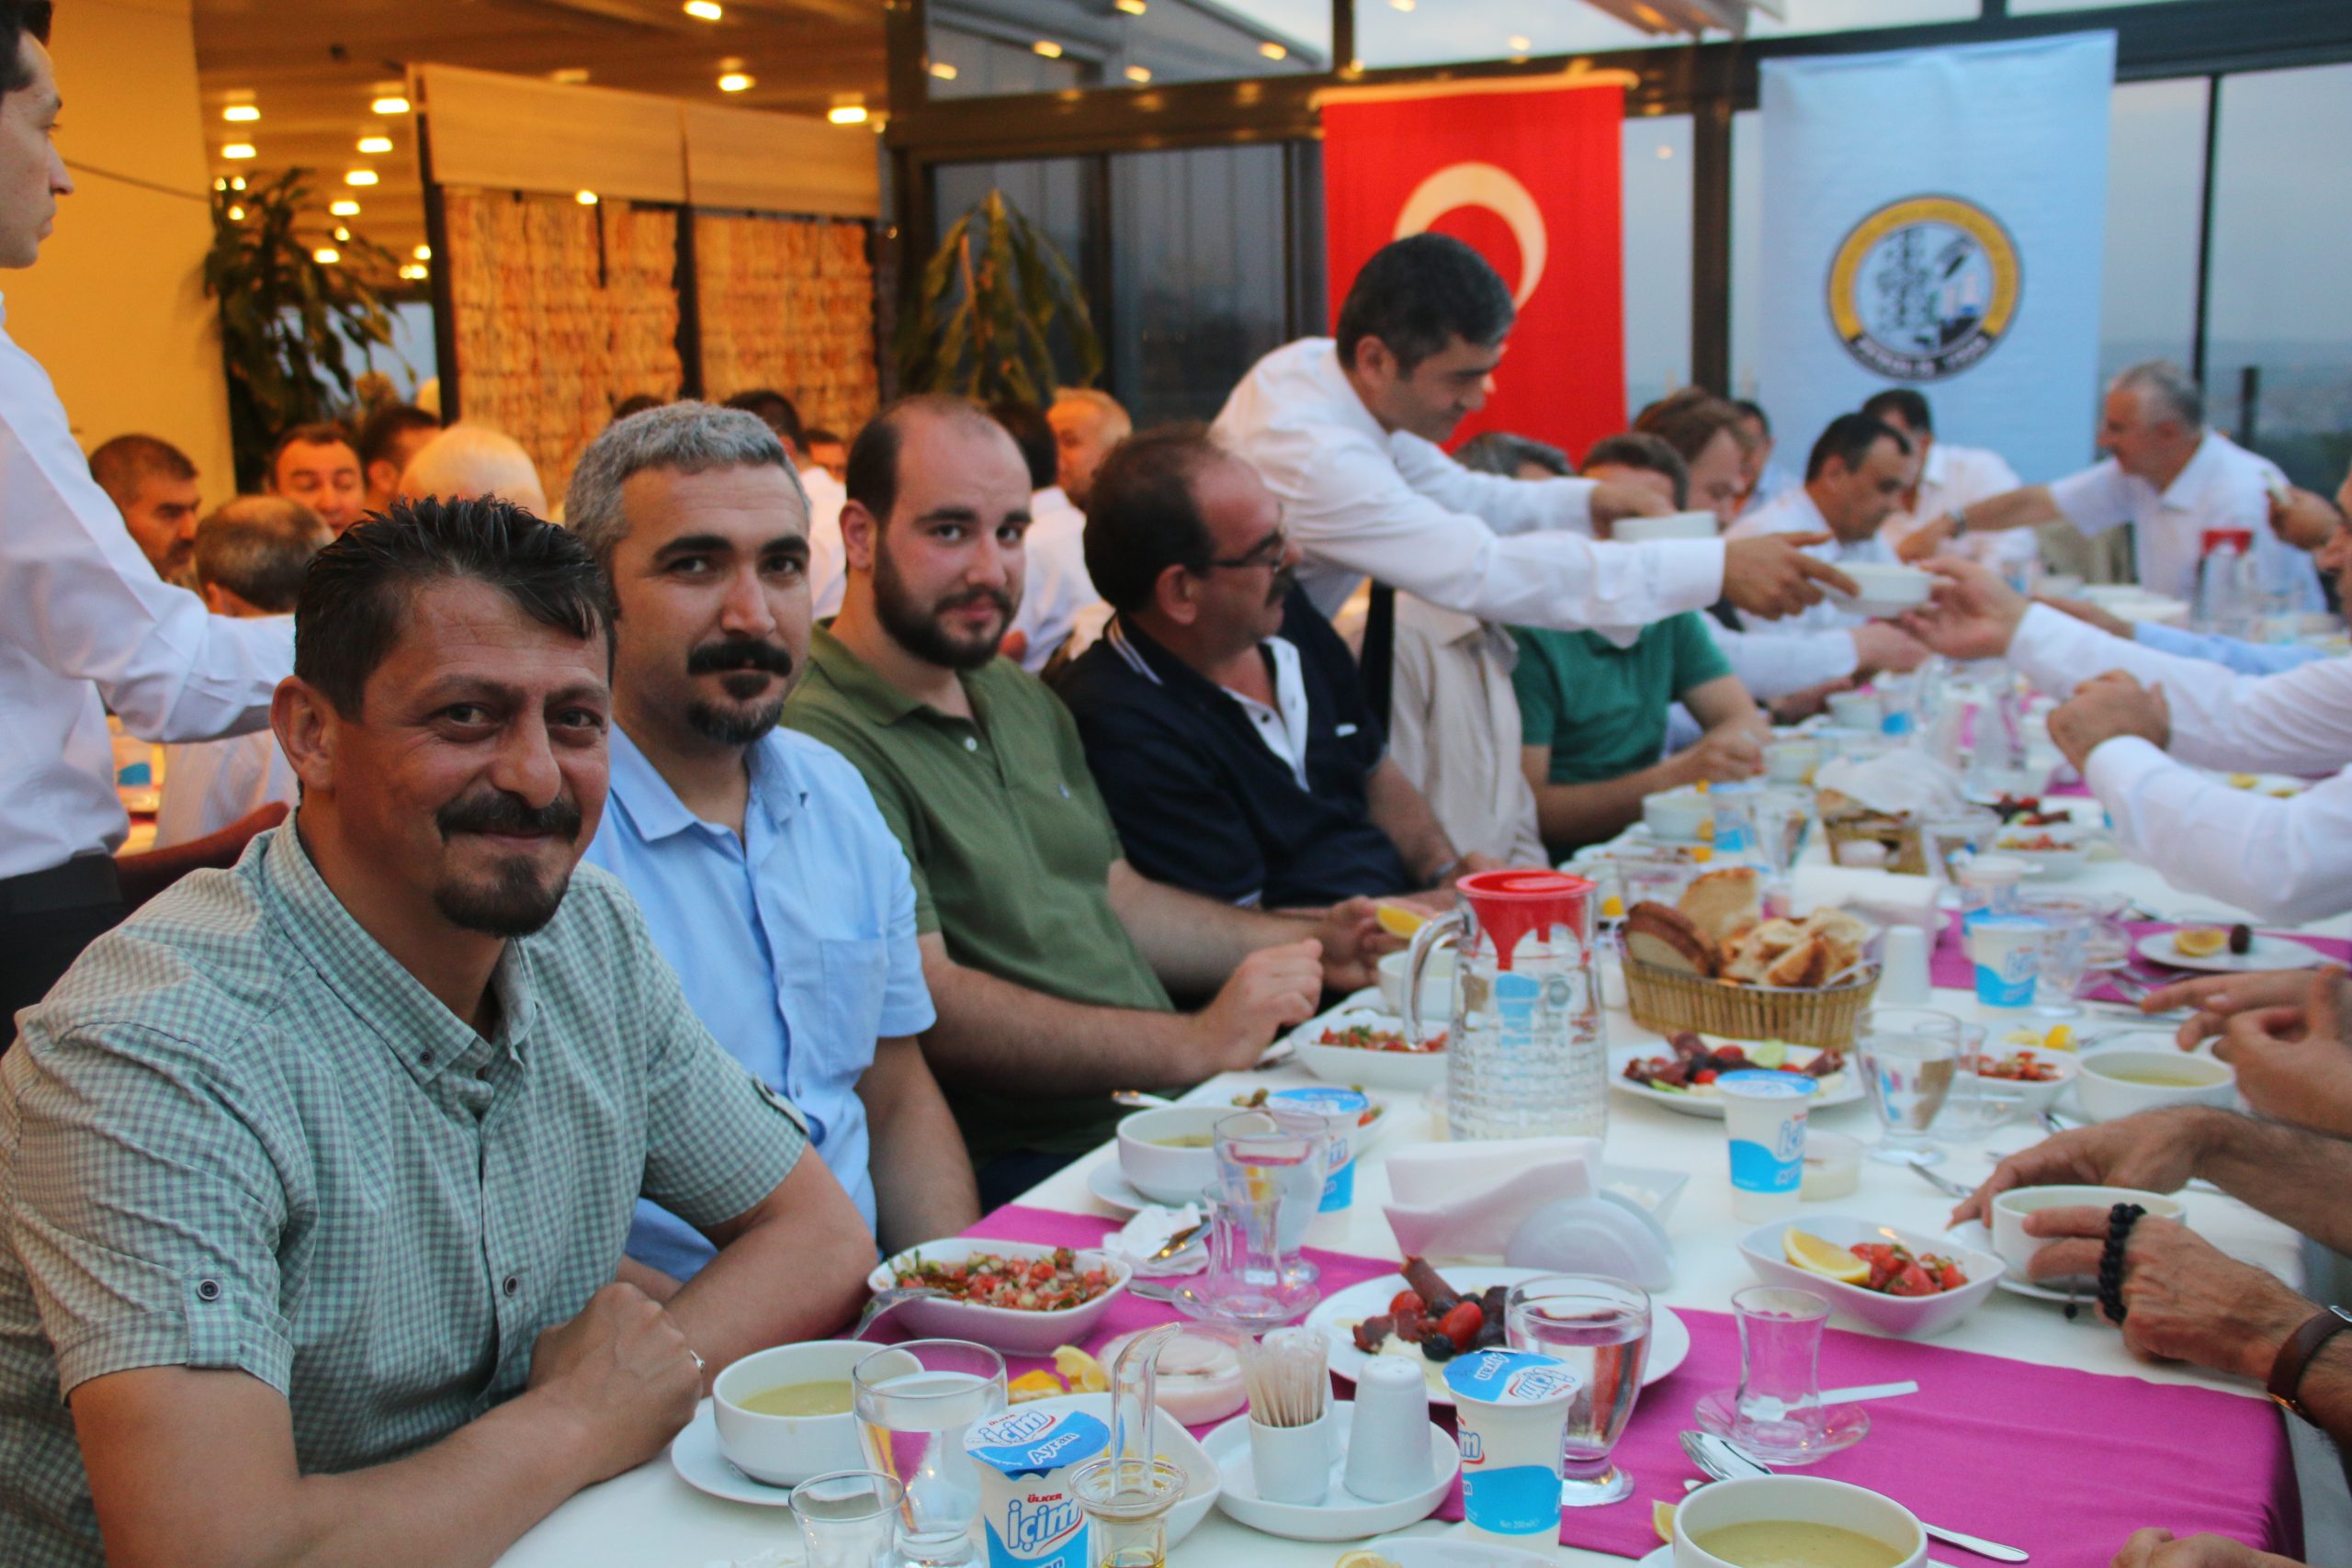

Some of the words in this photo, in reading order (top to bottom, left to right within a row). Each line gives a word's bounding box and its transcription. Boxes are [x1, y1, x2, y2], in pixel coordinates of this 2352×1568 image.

[1474, 1352, 1510, 1382] Ayran
[1027, 1433, 1081, 1466] Ayran
[1027, 1493, 1063, 1504] ÜLKER
